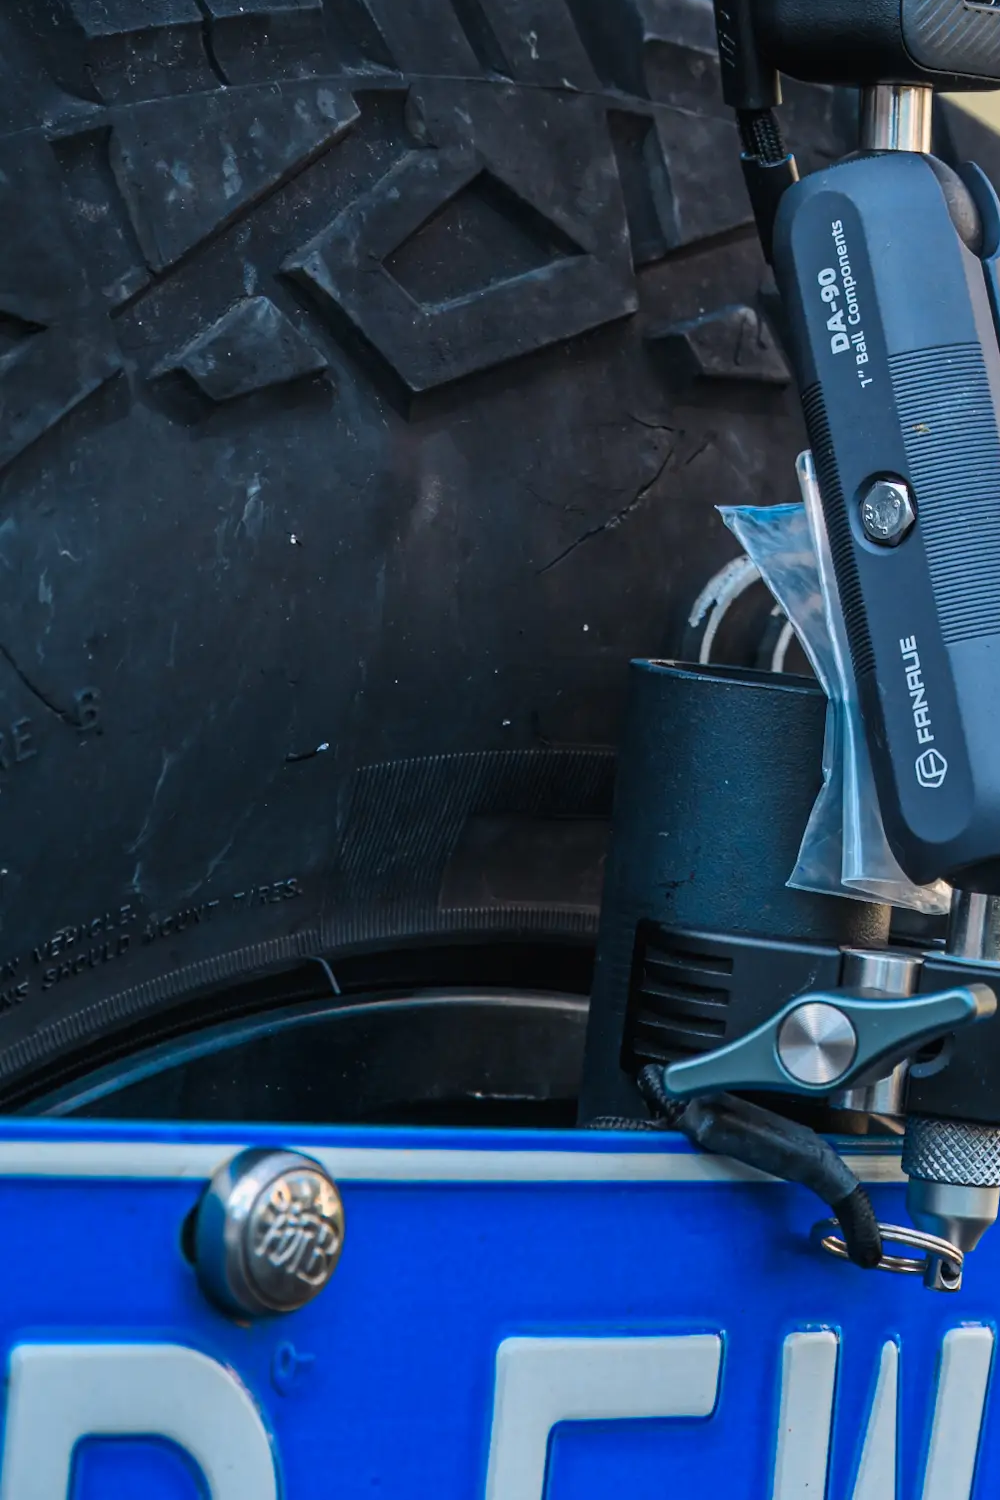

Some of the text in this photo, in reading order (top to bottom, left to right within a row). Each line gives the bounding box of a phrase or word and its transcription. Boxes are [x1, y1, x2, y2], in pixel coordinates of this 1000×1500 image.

[830, 219, 861, 325] Components
[817, 267, 851, 355] DA-90
[851, 330, 870, 365] Ball
[41, 934, 131, 991] SHOULD
